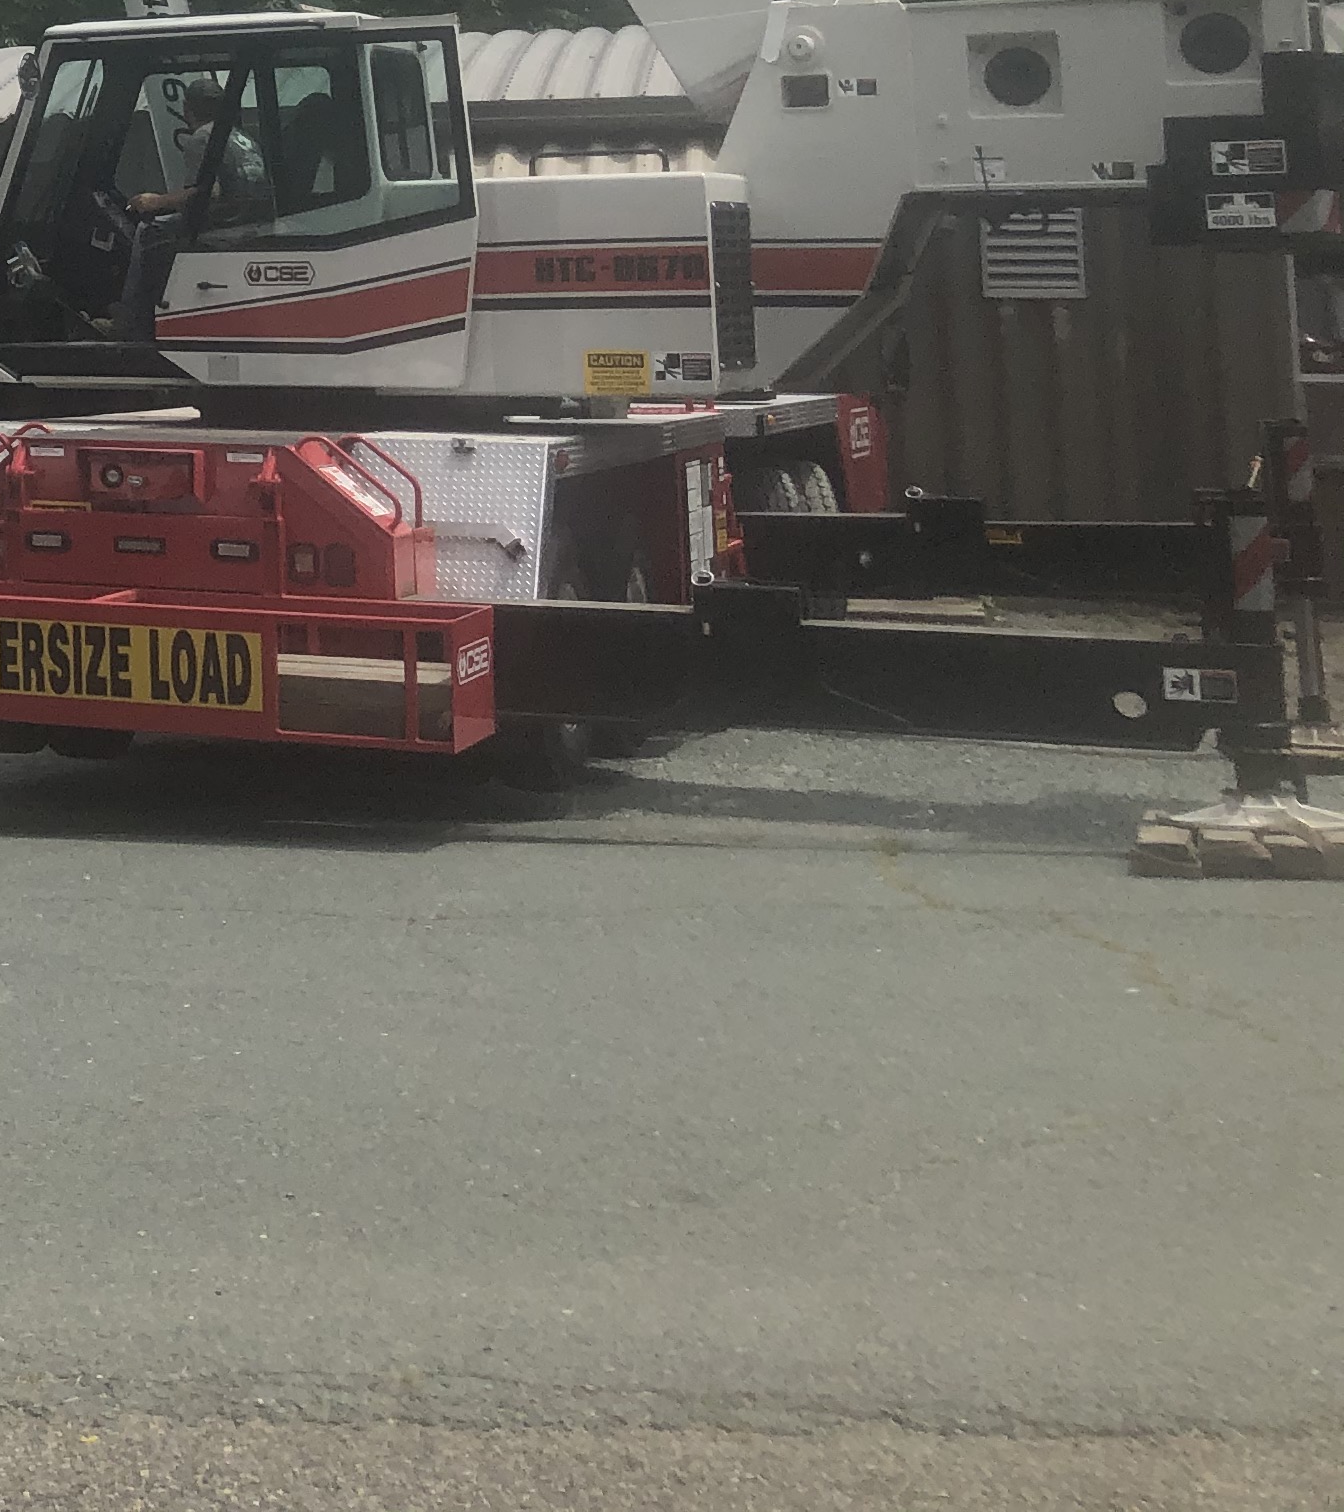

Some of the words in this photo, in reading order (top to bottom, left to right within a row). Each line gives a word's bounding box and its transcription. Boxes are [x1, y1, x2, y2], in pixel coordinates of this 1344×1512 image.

[1212, 214, 1244, 226] 4000
[264, 265, 309, 282] CSE
[589, 355, 643, 367] CAUTION
[148, 628, 252, 706] LOAD
[466, 643, 489, 676] CSE
